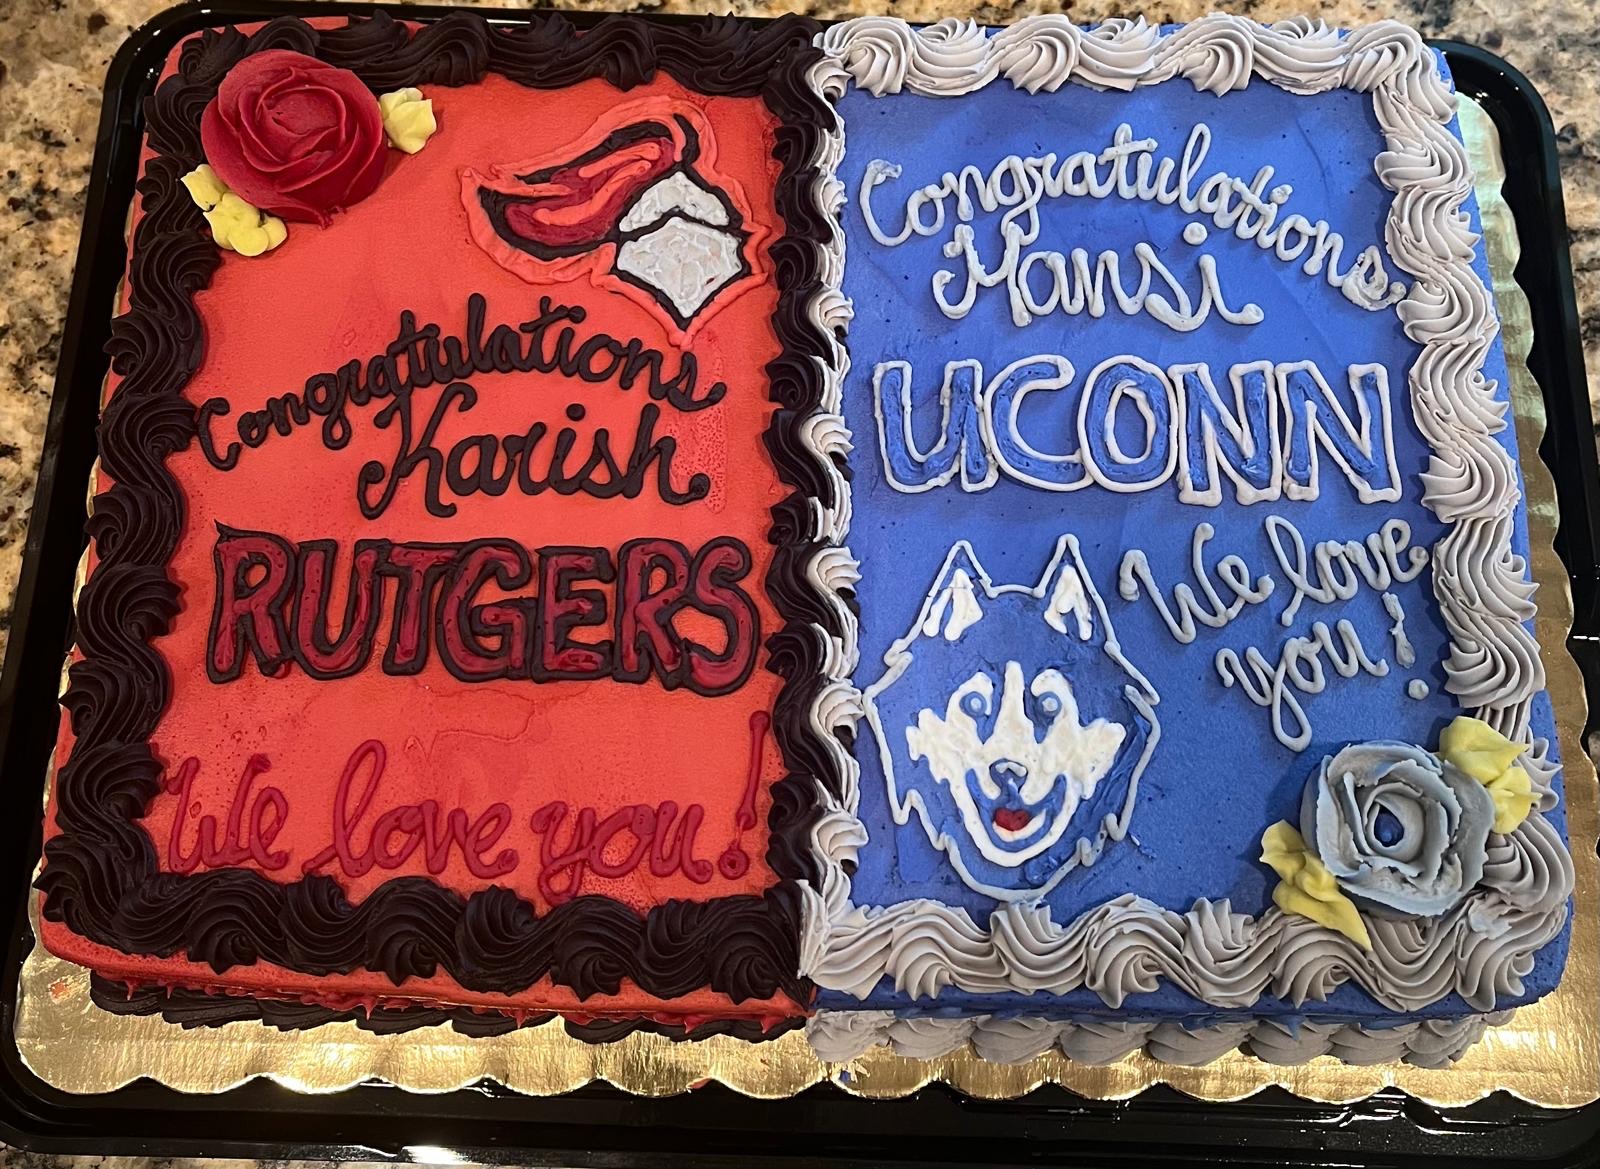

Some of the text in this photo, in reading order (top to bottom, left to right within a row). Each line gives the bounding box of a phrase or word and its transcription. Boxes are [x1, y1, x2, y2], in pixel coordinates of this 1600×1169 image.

[860, 122, 1406, 312] Congratulations
[932, 220, 1265, 332] Mansi
[199, 292, 727, 471] Congratulations
[358, 383, 711, 520] Karish
[873, 354, 1402, 507] UCONN
[206, 520, 760, 697] RUTGERS
[1118, 514, 1430, 645] We love
[1215, 591, 1430, 752] you!
[164, 710, 770, 908] We love you!
